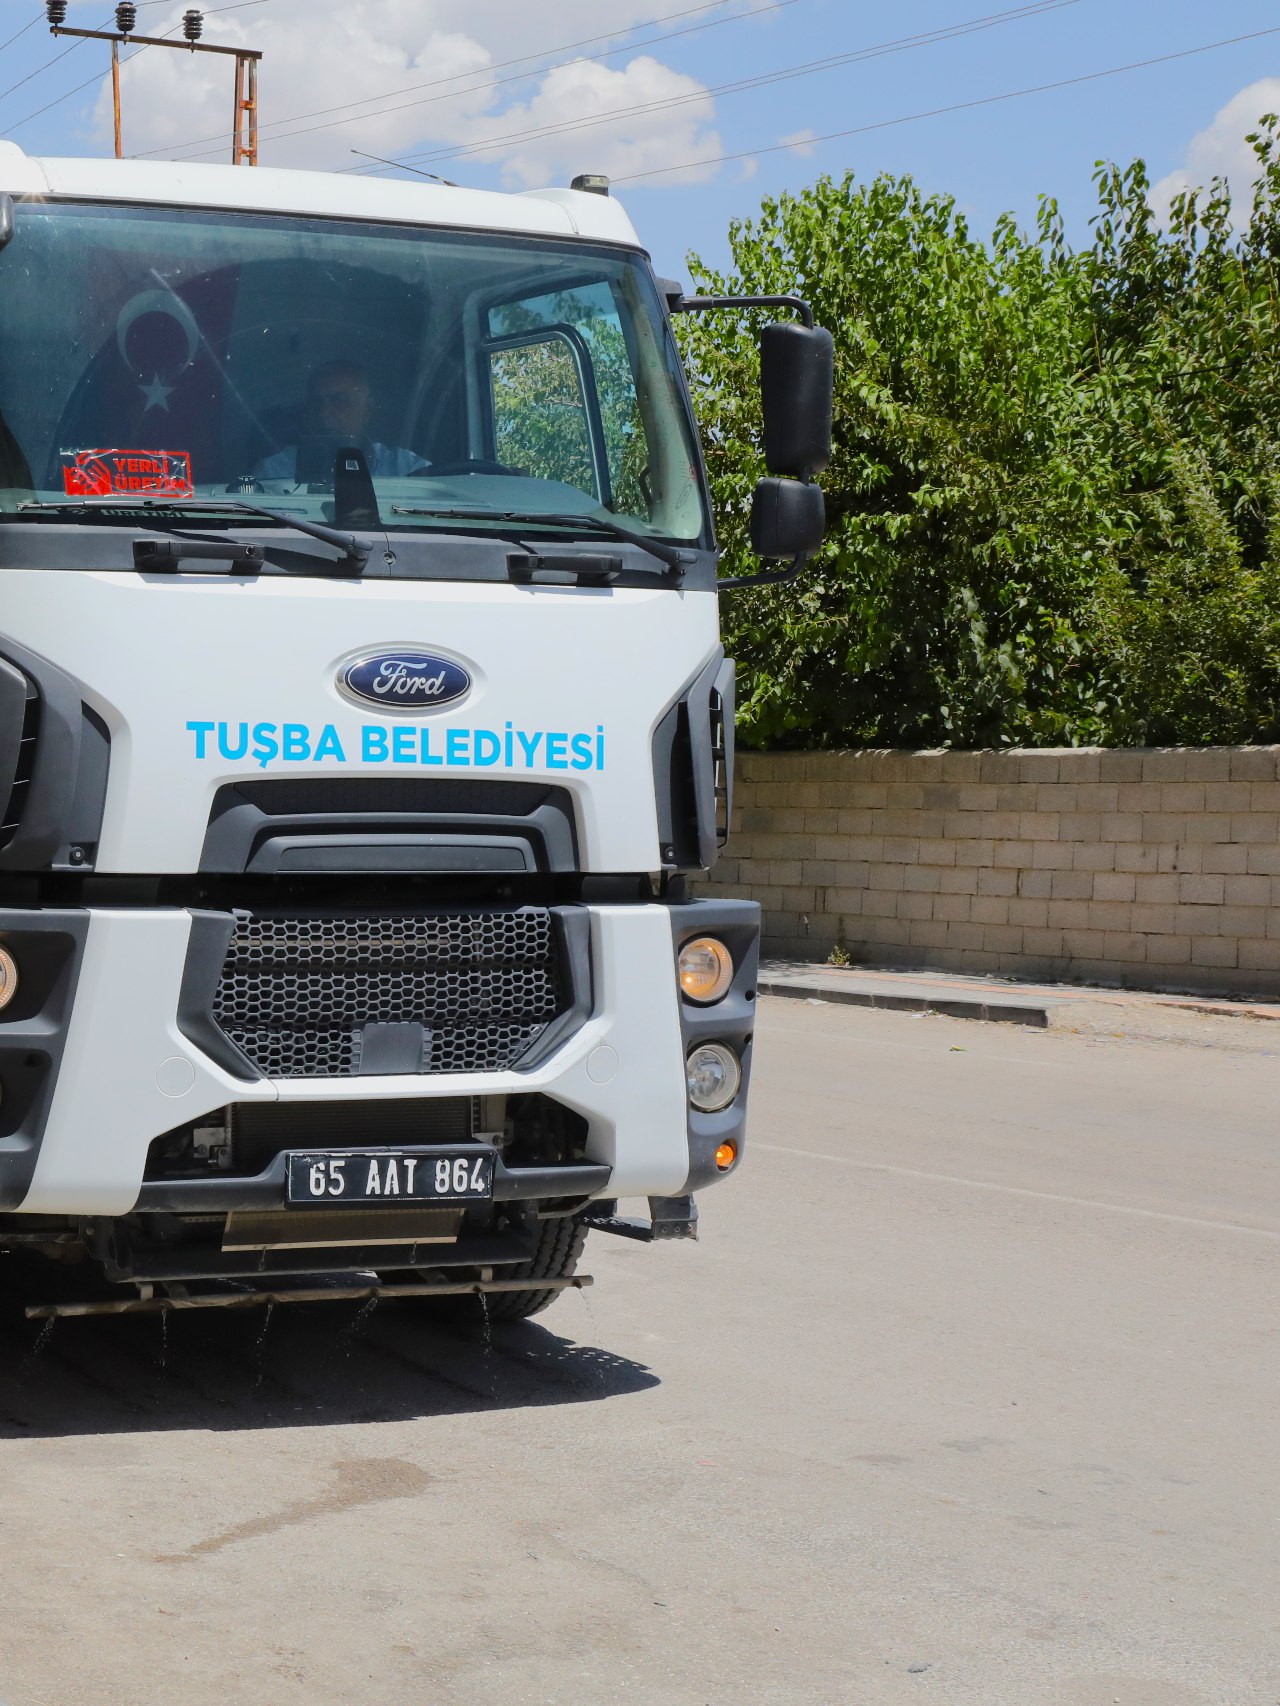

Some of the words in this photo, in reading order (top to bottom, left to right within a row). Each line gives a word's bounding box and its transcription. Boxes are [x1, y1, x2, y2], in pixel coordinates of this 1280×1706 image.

[112, 456, 169, 474] YERLİ
[114, 473, 187, 492] ÜRETİM
[372, 660, 447, 696] Ford
[185, 721, 347, 769] TUŞBA
[361, 720, 605, 770] BELEDİYESİ
[309, 1160, 346, 1196] 65
[365, 1159, 418, 1195] AAT
[434, 1157, 486, 1194] 864
